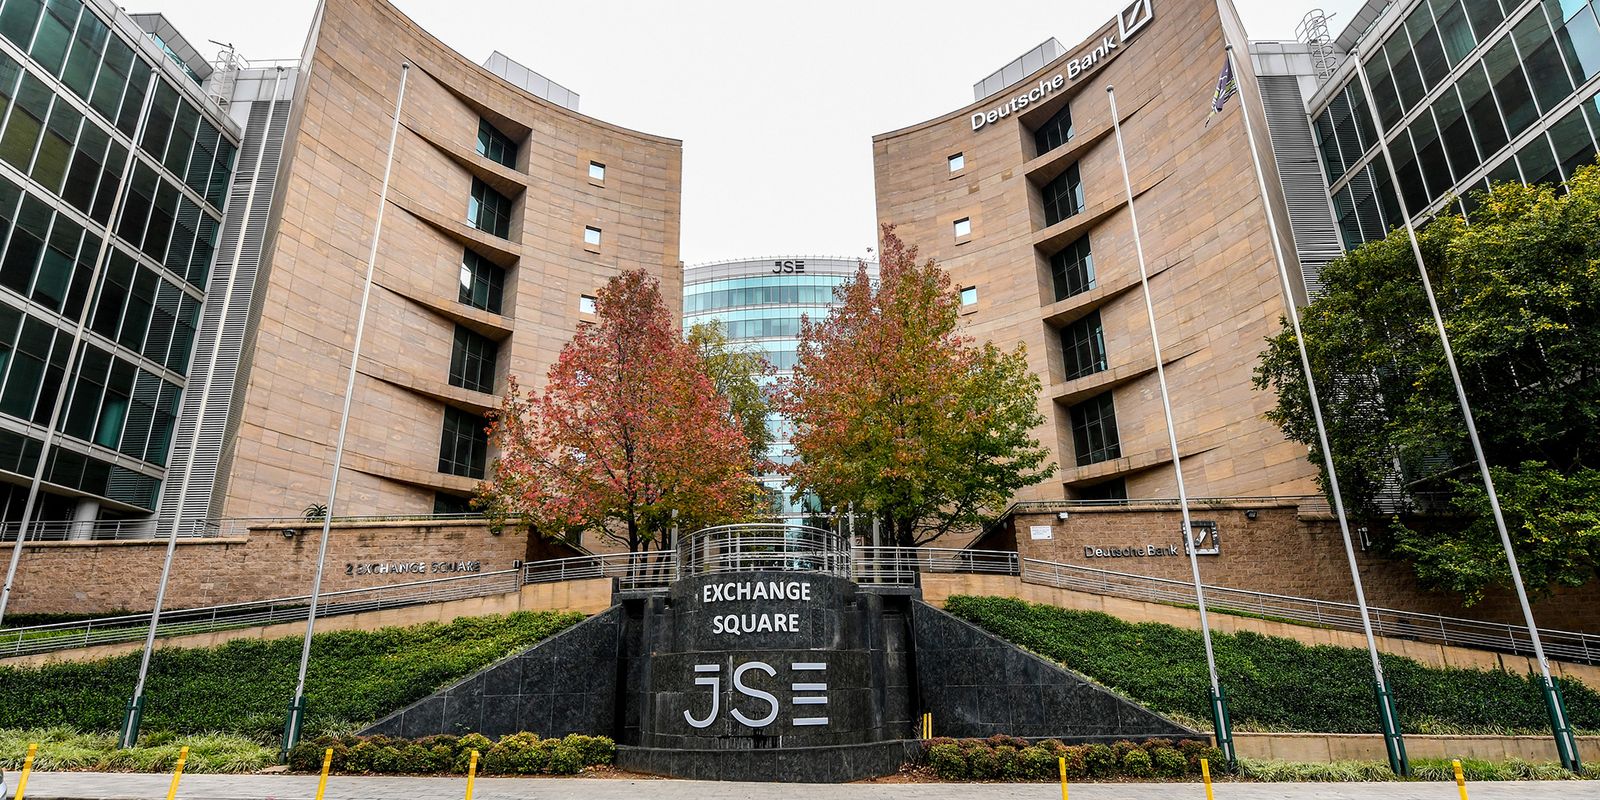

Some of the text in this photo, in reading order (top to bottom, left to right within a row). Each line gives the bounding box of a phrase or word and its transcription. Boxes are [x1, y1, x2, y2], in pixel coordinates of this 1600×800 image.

[971, 34, 1118, 131] Deutsche Bank
[772, 260, 805, 274] JSE
[1084, 544, 1179, 558] Deutsche Bank
[345, 560, 481, 576] 2 EXCHANGE SQUARE
[703, 581, 811, 603] EXCHANGE
[712, 613, 800, 636] SQUARE
[683, 661, 829, 729] JSE
